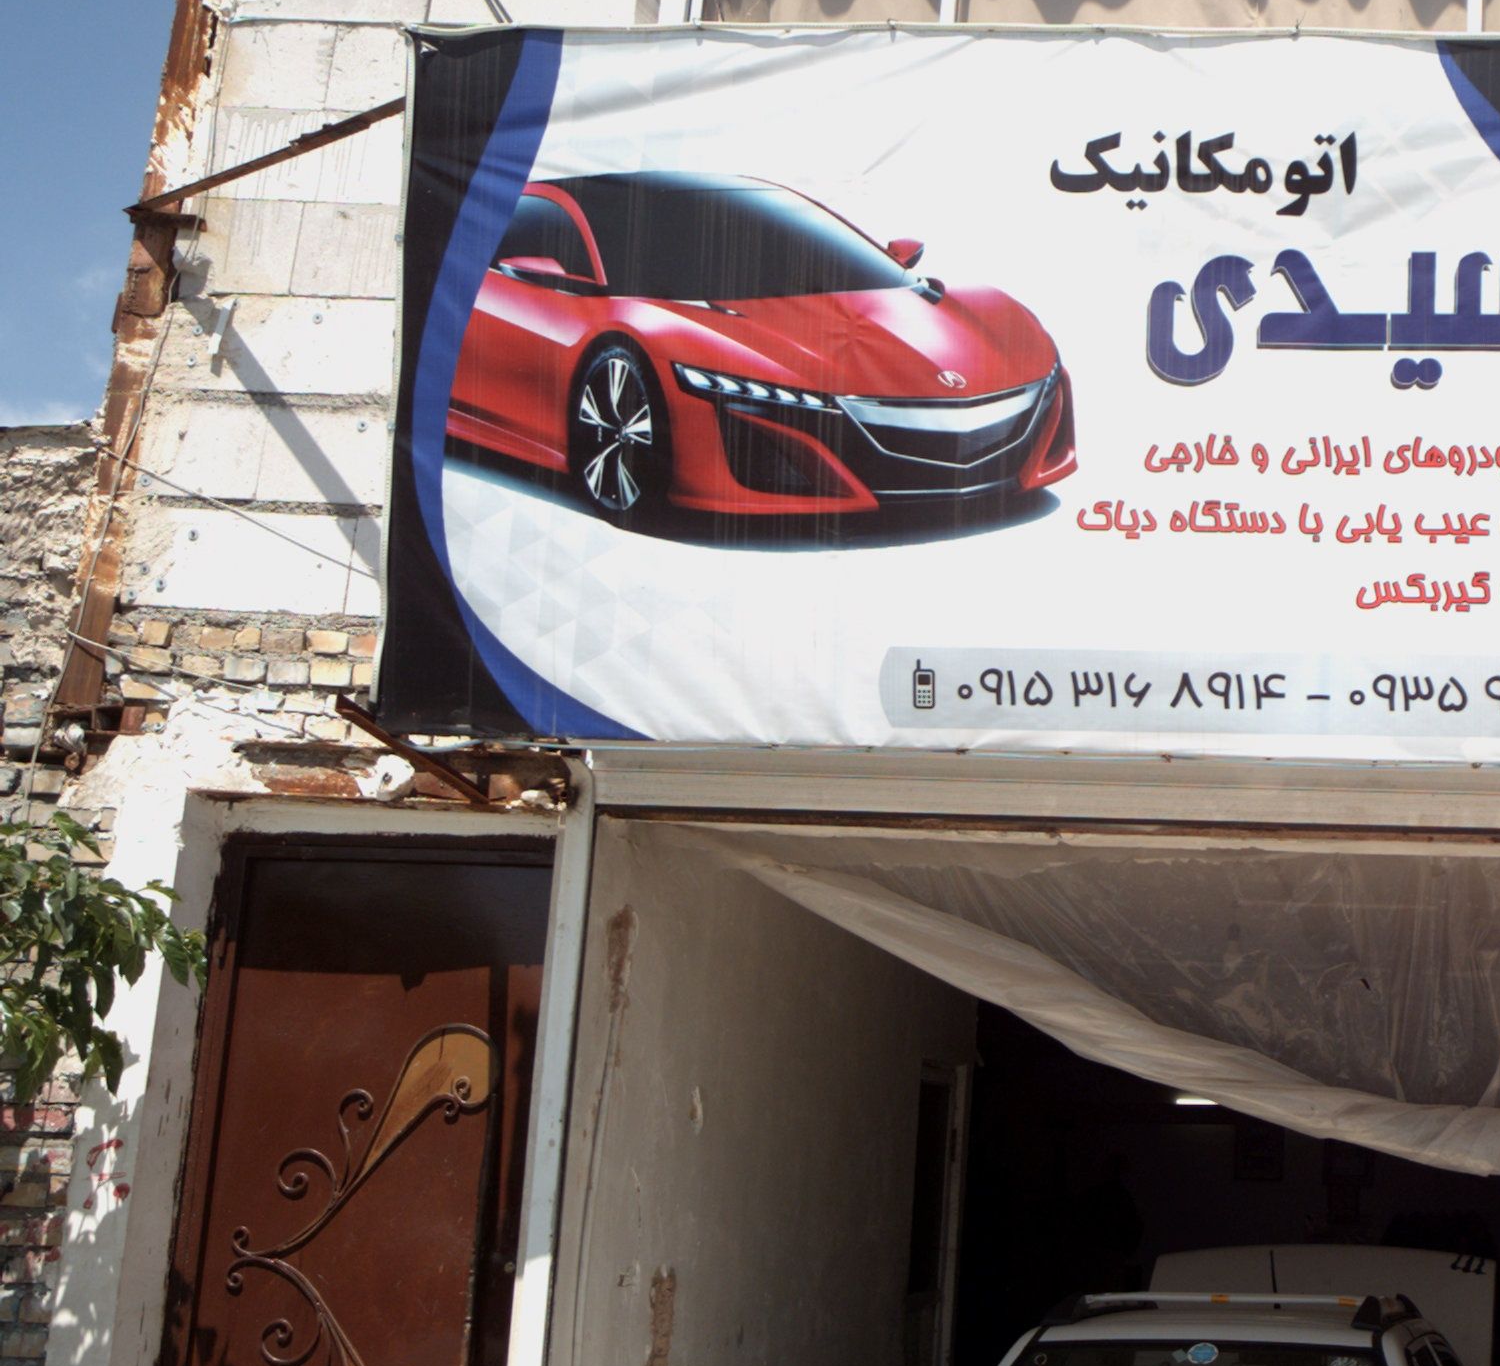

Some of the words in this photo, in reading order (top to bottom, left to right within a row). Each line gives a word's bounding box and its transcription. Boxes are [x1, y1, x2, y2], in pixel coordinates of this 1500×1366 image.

[1144, 434, 1241, 475] خارجی
[1251, 442, 1271, 476] و
[1281, 436, 1373, 477] ایرانی
[1076, 499, 1159, 541] دیاک
[1169, 499, 1288, 536] دستگاه
[1299, 502, 1325, 545] با
[1335, 503, 1404, 546] یابی
[1414, 512, 1492, 546] عیب
[1355, 570, 1493, 614] گیربکس
[957, 667, 1054, 707] ۰۹۱۵
[1070, 670, 1153, 710] ۳۱۶
[1170, 671, 1288, 712] ۸۹۱۴
[1349, 673, 1469, 714] ۰۹۳۵
